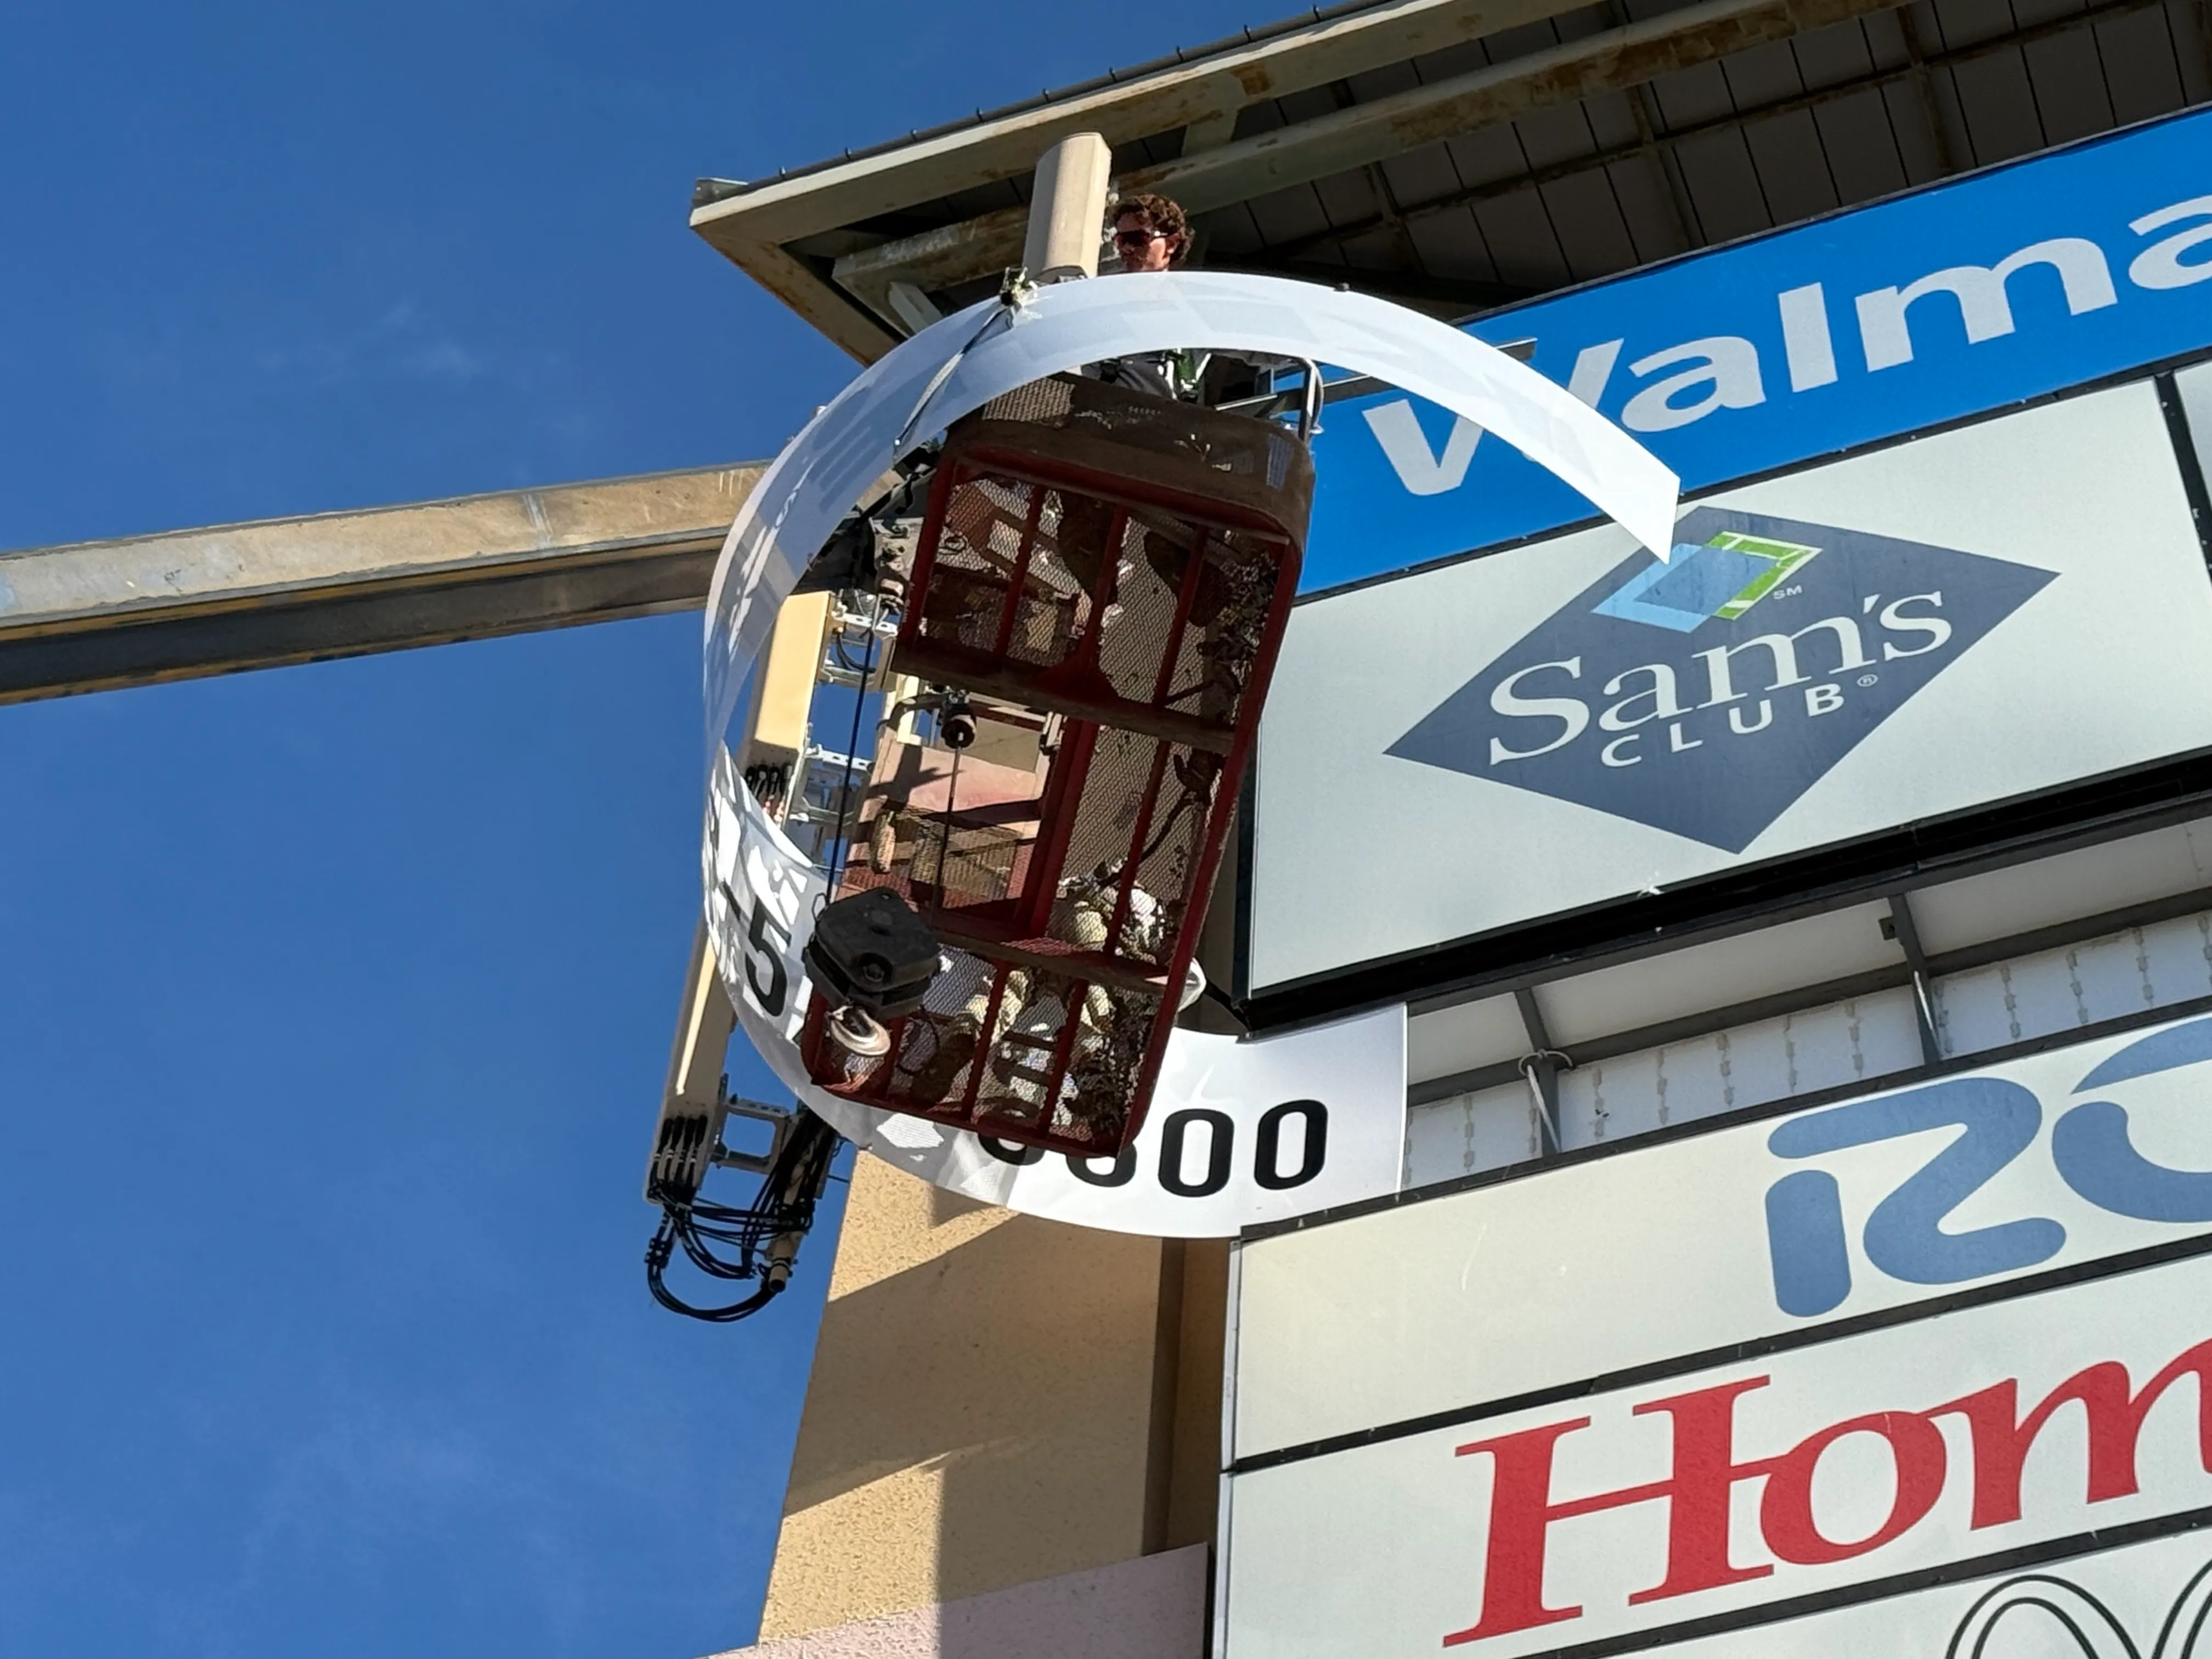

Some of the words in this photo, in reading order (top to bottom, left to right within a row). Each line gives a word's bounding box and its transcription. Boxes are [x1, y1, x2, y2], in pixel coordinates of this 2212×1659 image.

[1773, 584, 1802, 599] SM
[1490, 590, 1952, 765] Sam's
[1601, 684, 1844, 767] CLUB
